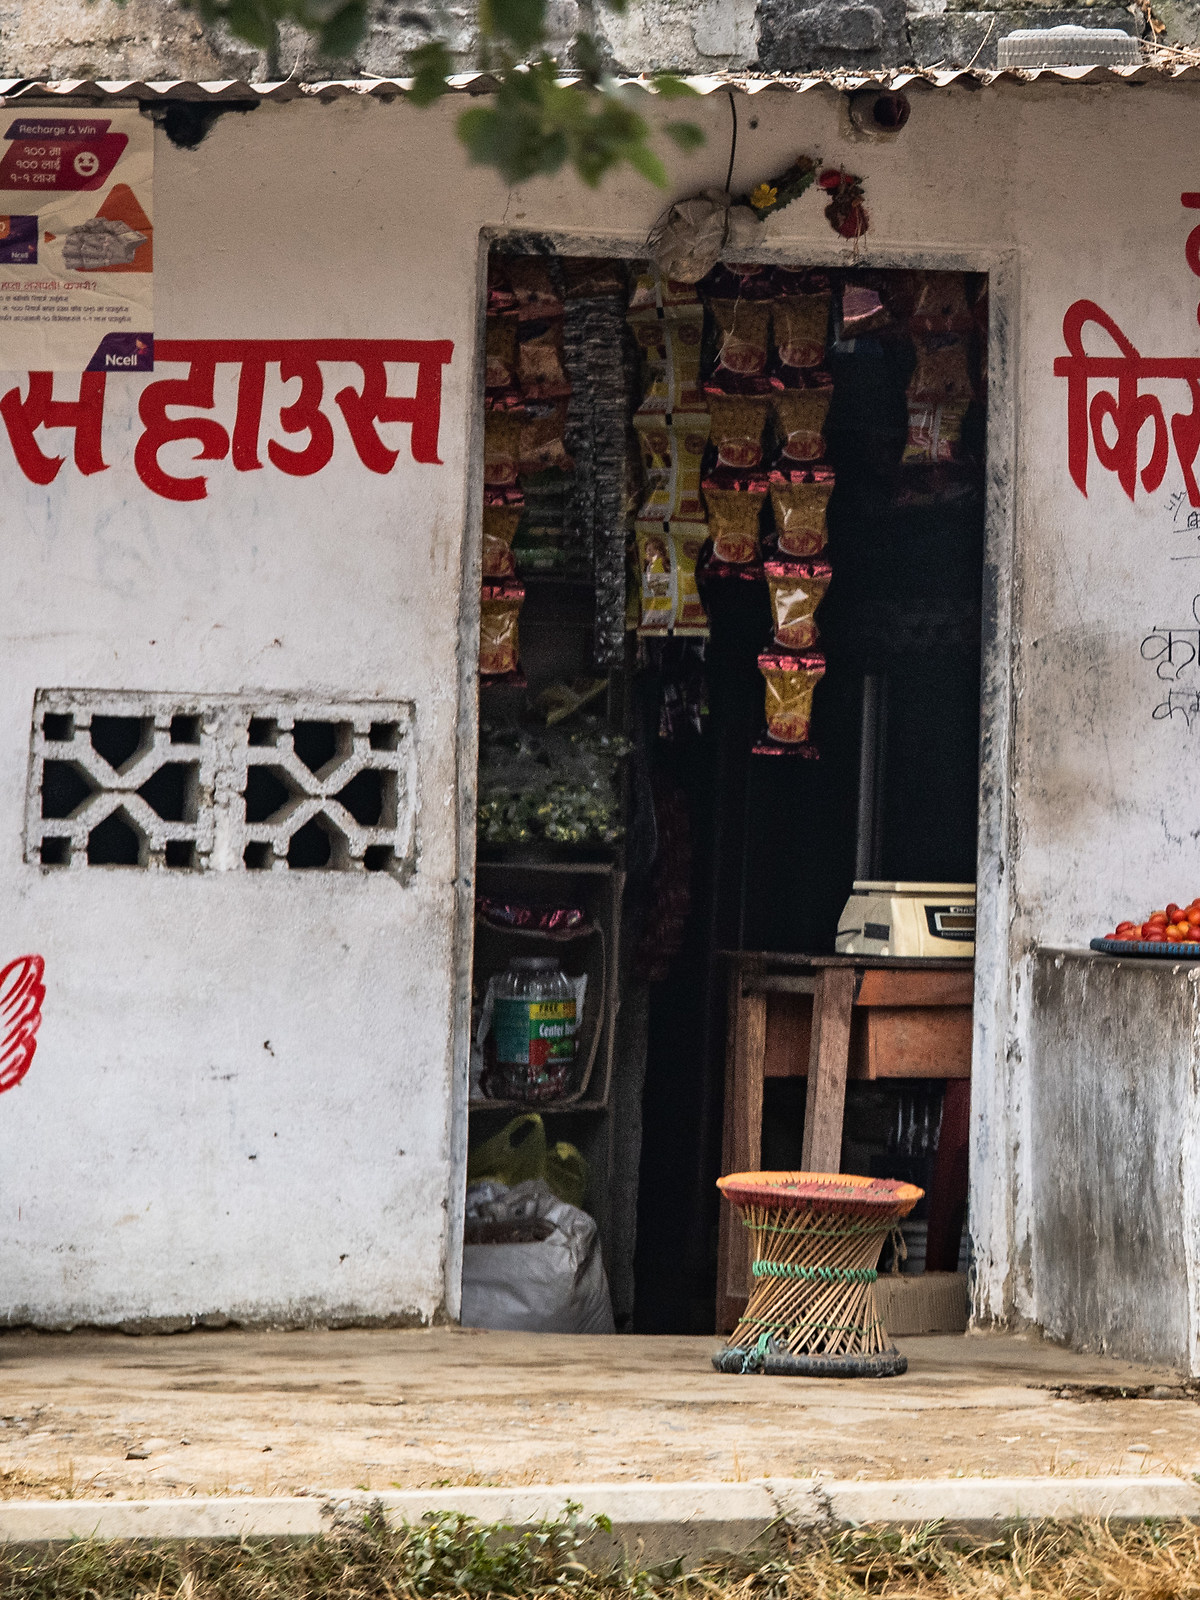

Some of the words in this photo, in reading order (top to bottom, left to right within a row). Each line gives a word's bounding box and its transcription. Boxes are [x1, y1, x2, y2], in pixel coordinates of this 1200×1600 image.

[19, 125, 65, 136] Recharge
[68, 126, 75, 134] &
[79, 126, 96, 134] Win
[105, 354, 137, 366] Ncell
[134, 339, 454, 502] हाउस
[539, 1023, 564, 1037] Center
